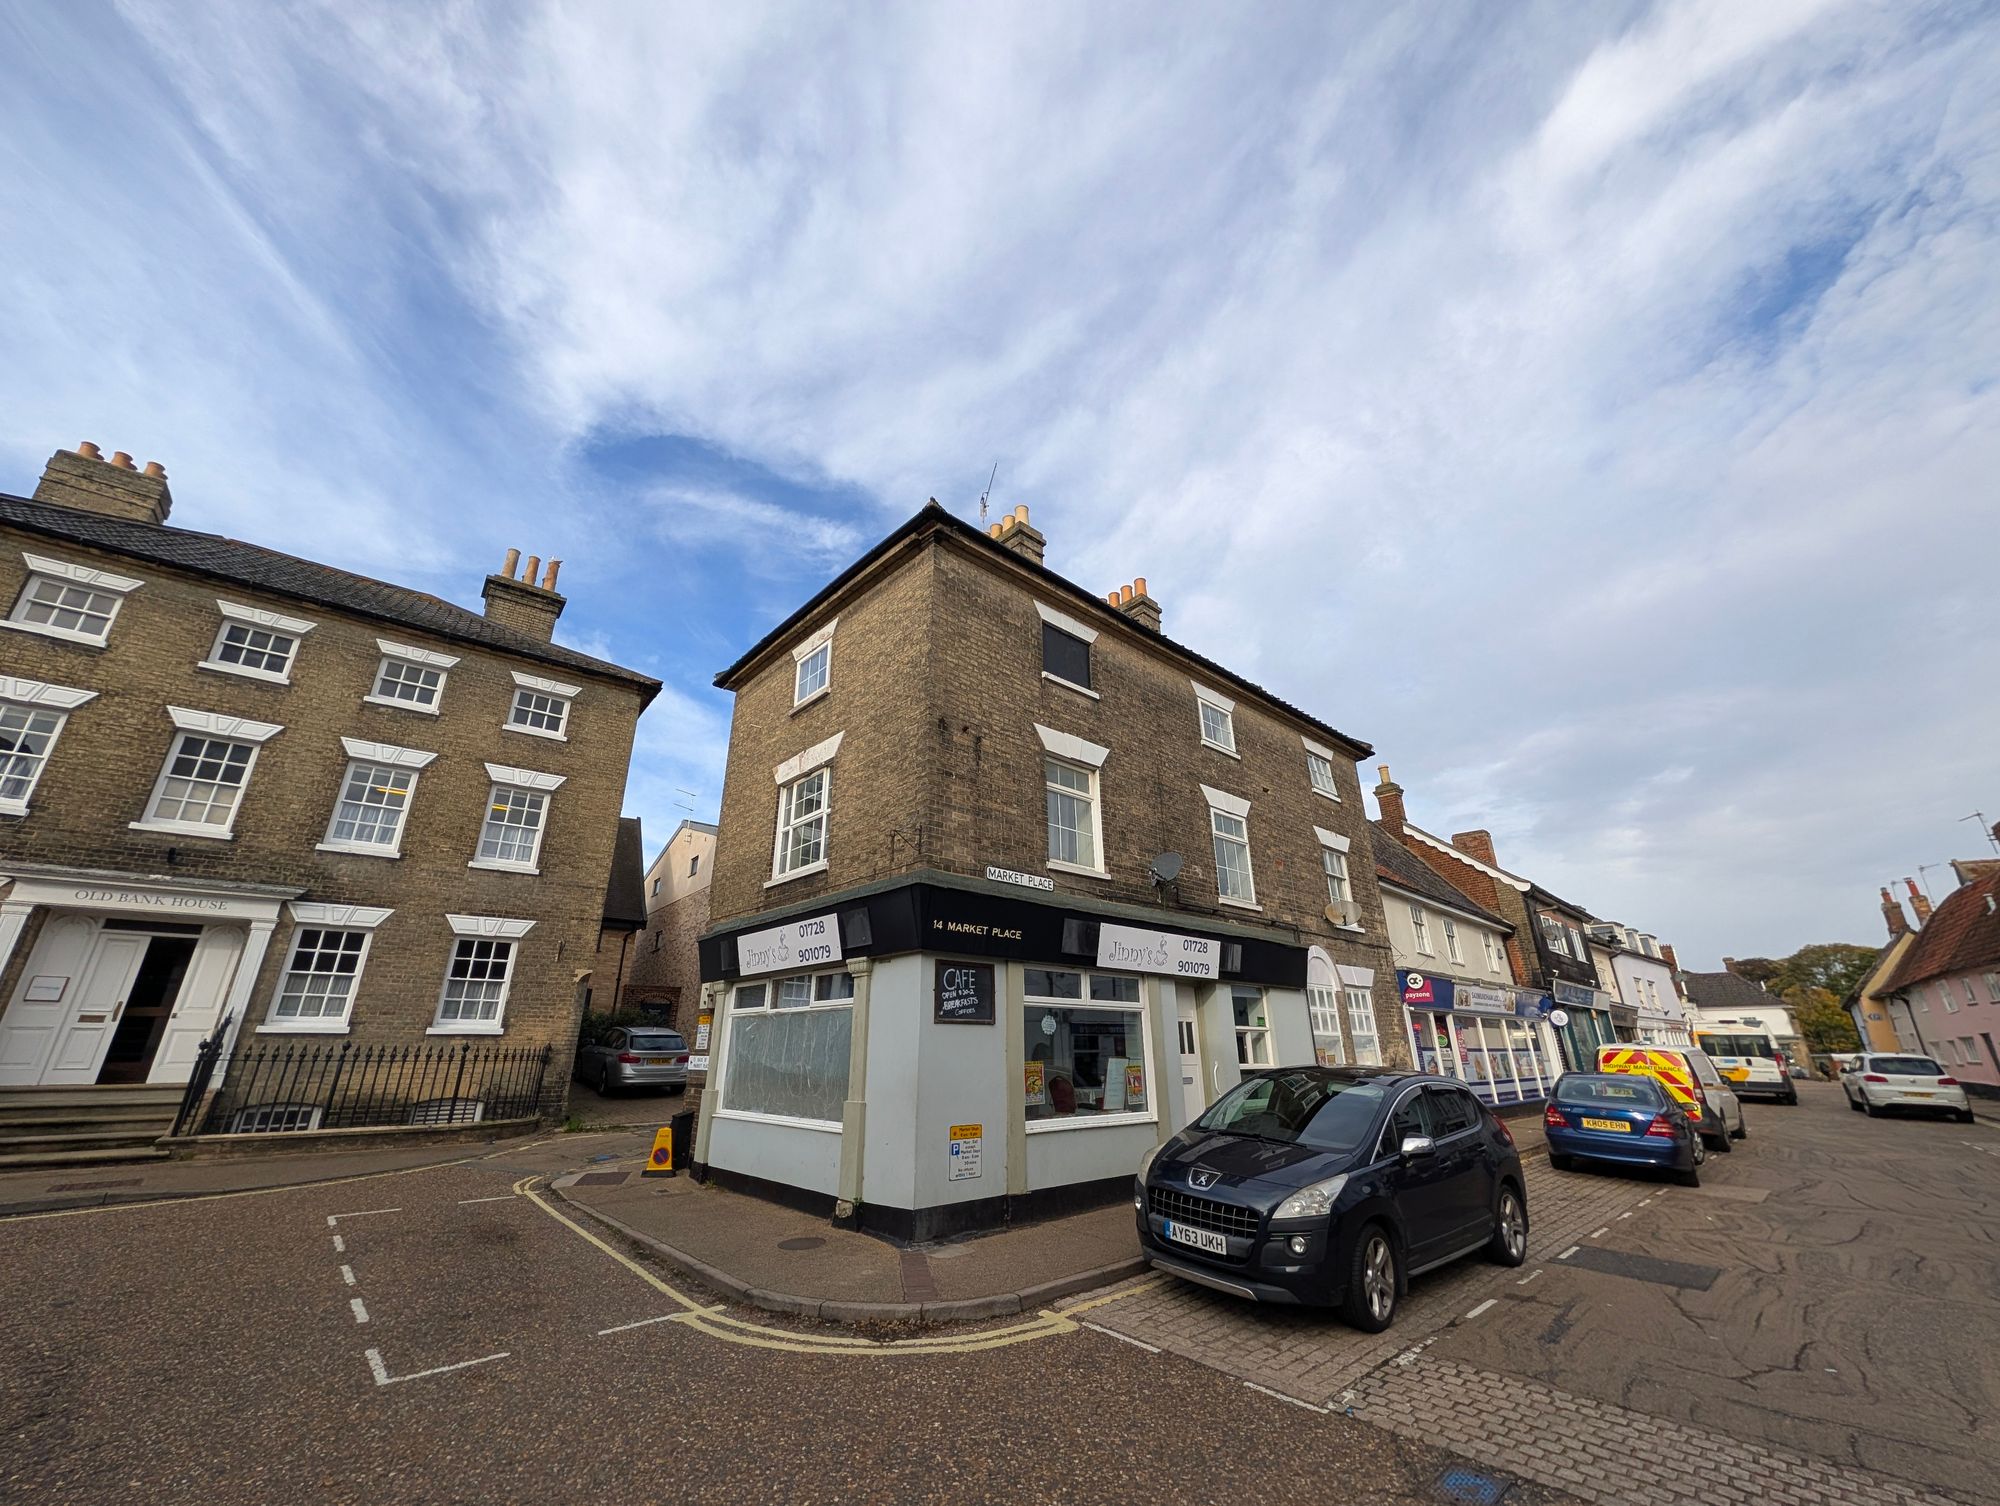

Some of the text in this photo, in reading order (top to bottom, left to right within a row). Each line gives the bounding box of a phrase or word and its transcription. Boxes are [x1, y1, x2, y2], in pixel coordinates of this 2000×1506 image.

[988, 868, 1053, 889] MARKET PLACE
[75, 889, 228, 910] OLD BANK HOUSE
[799, 921, 825, 938] 01728
[933, 920, 1022, 940] 14 MARKET PLACE
[798, 944, 831, 963] 901079
[1108, 940, 1153, 967] Jinny's
[1183, 939, 1208, 954] 01728
[746, 946, 777, 968] Jinny's
[1178, 960, 1210, 975] 901079
[943, 968, 976, 990] CAFE
[941, 990, 957, 999] OPEN
[943, 997, 979, 1010] BREAKFASTS
[1609, 1121, 1626, 1129] EHN
[1171, 1224, 1223, 1252] AY63 UKH
